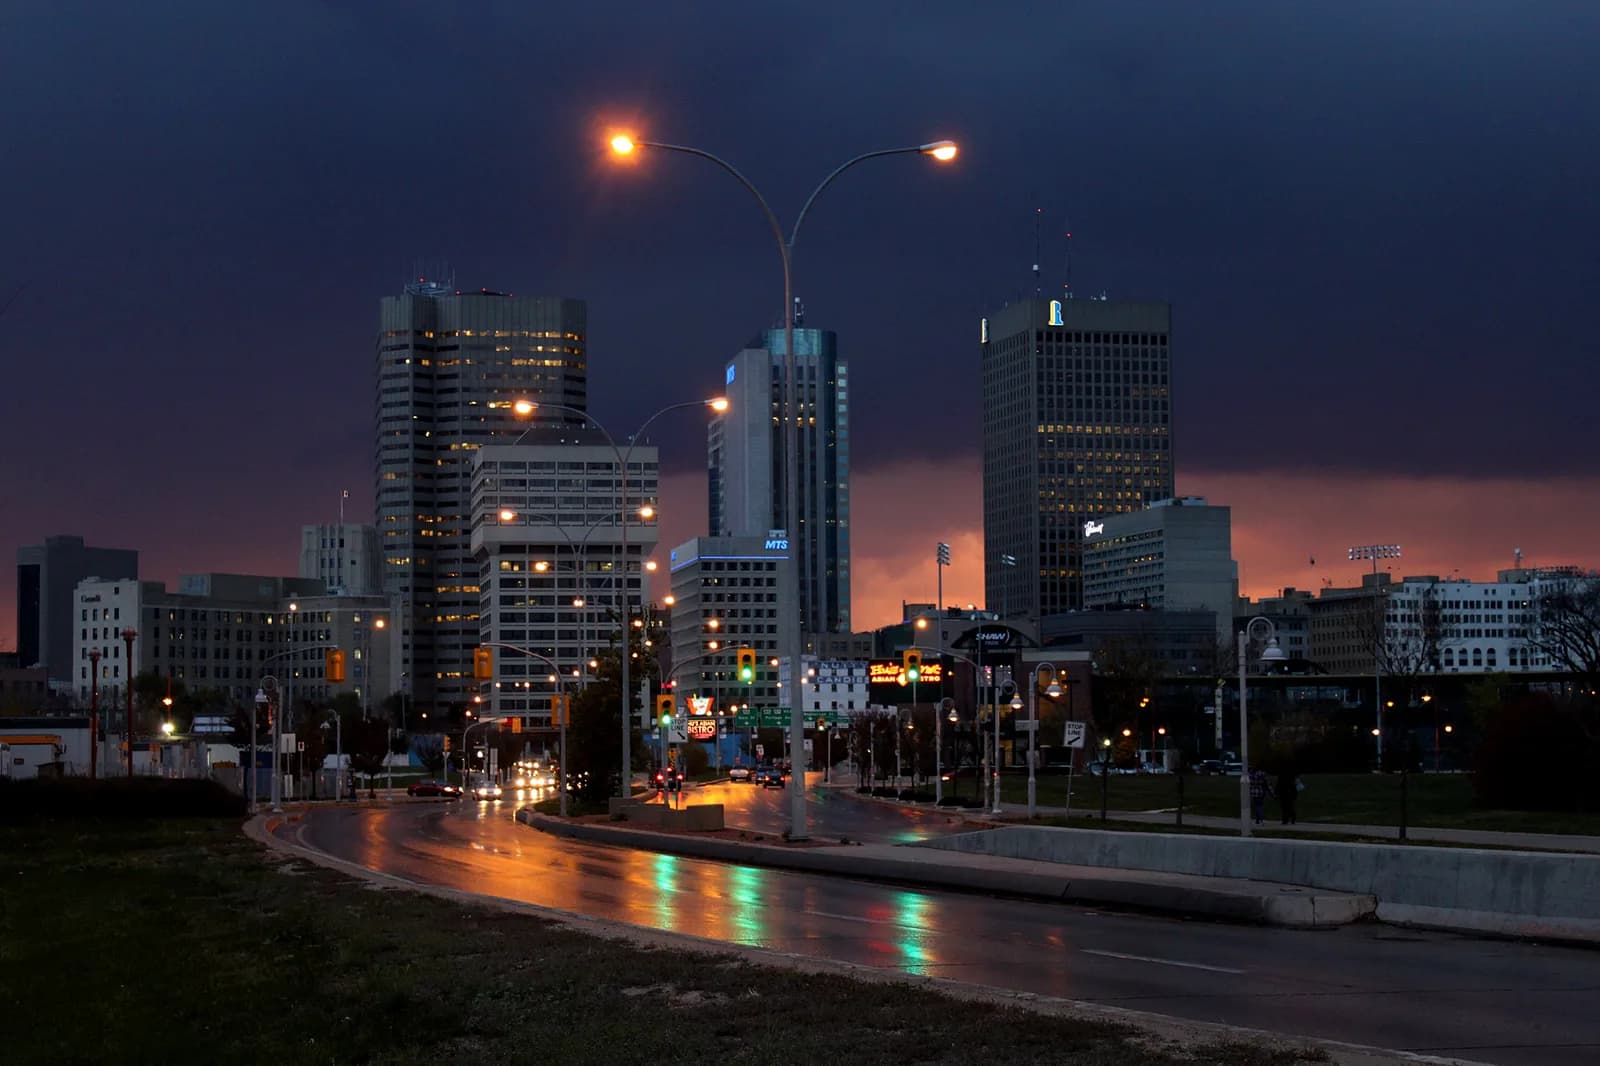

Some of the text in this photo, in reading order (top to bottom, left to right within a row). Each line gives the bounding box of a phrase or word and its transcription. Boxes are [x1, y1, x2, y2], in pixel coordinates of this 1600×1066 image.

[765, 539, 789, 550] MTS
[975, 632, 1006, 641] SHAW
[687, 726, 714, 734] BISTRO
